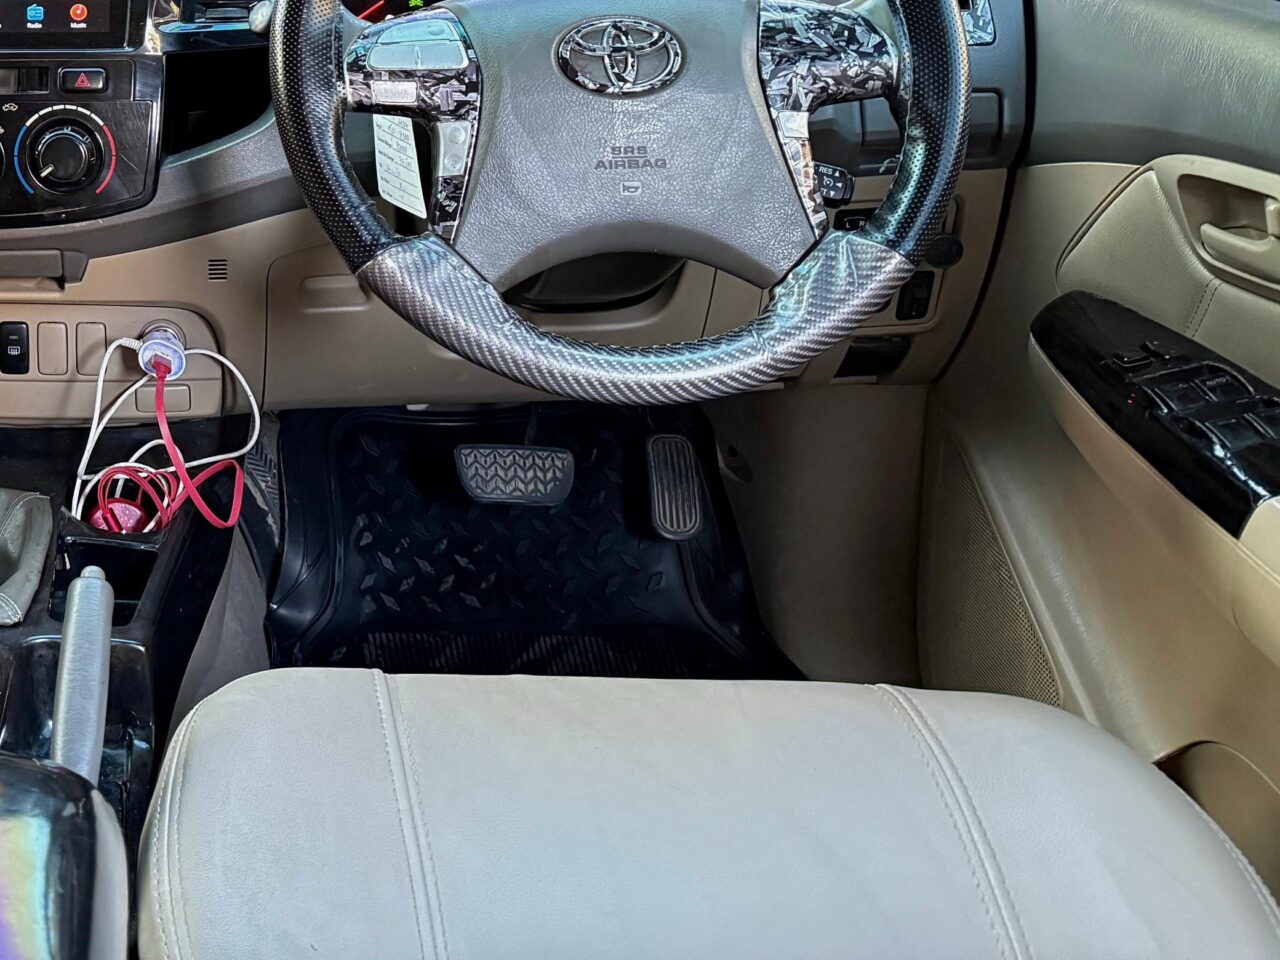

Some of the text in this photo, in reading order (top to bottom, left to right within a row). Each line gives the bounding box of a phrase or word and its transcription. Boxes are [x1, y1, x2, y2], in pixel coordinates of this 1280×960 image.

[612, 145, 648, 155] SRS
[594, 159, 667, 170] AIRBAG
[819, 166, 833, 175] RES
